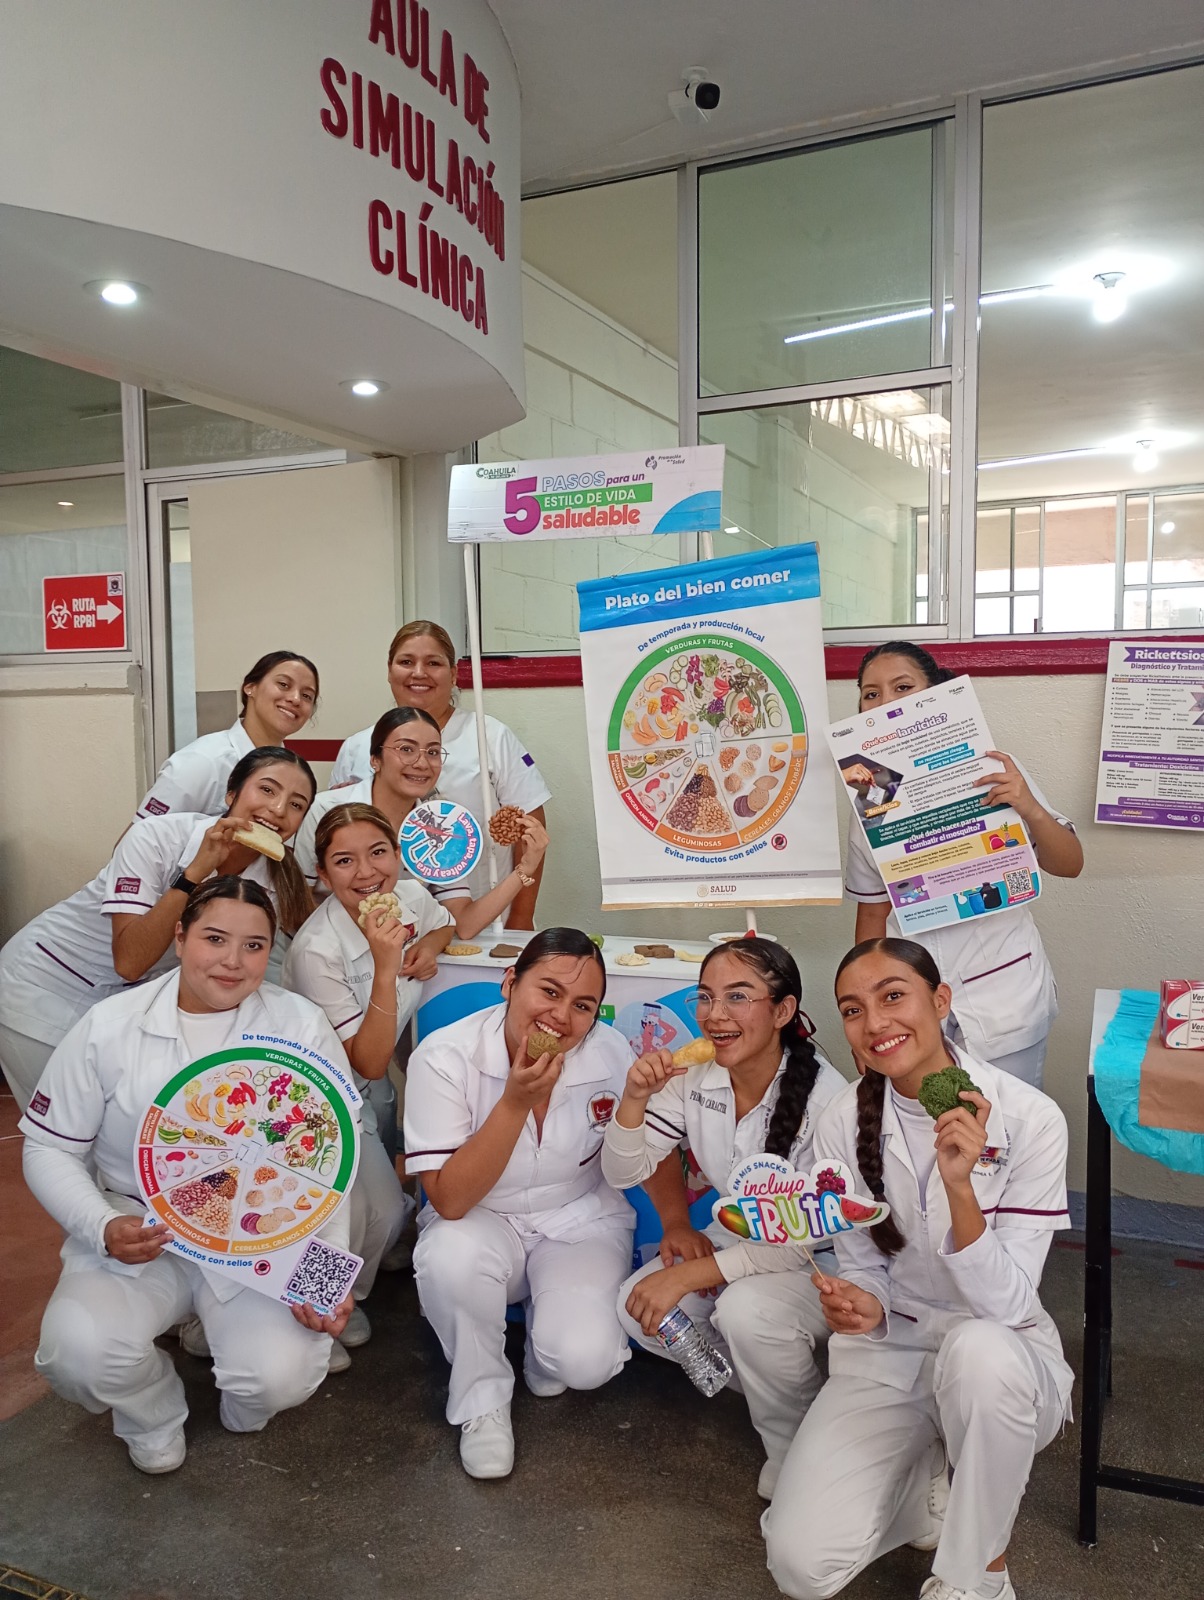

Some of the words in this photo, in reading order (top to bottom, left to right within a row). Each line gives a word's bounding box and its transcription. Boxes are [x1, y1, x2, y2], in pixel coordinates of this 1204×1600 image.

[368, 0, 457, 106] AULA
[464, 53, 490, 144] DE
[320, 57, 505, 261] SIMULACIÓN
[368, 199, 488, 335] CLÍNICA
[503, 476, 542, 535] 5
[542, 470, 606, 492] PASOS
[606, 475, 630, 487] para
[632, 472, 645, 482] un
[544, 492, 584, 508] ESTILO
[586, 491, 602, 504] DE
[605, 488, 636, 502] VIDA
[542, 504, 640, 530] saludable
[605, 593, 650, 610] Plato
[654, 585, 682, 602] del
[686, 580, 726, 598] bien
[731, 570, 791, 590] comer
[72, 598, 96, 612] RUTA
[74, 614, 96, 628] RPBI
[637, 641, 649, 653] De
[649, 622, 692, 645] temporada
[692, 622, 698, 630] y
[700, 620, 744, 633] producción
[745, 628, 765, 643] local
[665, 640, 702, 655] VERDURAS
[708, 639, 734, 648] FRUTAS
[860, 737, 879, 750] ¿Qué
[886, 731, 897, 740] un
[897, 712, 948, 738] larvicida?
[457, 812, 474, 836] Lava,
[909, 833, 925, 843] ¿Qué
[924, 827, 941, 837] debo
[941, 822, 959, 832] hacer
[960, 818, 976, 827] para
[910, 836, 939, 850] combatir
[945, 824, 980, 839] mosquito?
[464, 837, 477, 860] tapa,
[664, 846, 684, 861] Evita
[686, 854, 727, 864] productos
[729, 852, 744, 861] con
[745, 840, 768, 856] sellos
[672, 834, 722, 847] LEGUMINOSAS
[416, 860, 432, 876] tira
[440, 860, 468, 877] voltea
[710, 885, 737, 893] SALUD
[256, 1034, 302, 1051] temporada
[308, 1050, 346, 1085] producción
[344, 1084, 358, 1102] local
[264, 1052, 302, 1070] VERDURAS
[308, 1070, 331, 1091] FRUTAS
[732, 1178, 741, 1191] EN
[739, 1166, 752, 1179] MIS
[754, 1161, 787, 1174] SNACKS
[744, 1173, 805, 1200] incluyo
[164, 1211, 210, 1246] LEGUMINOSAS
[738, 1191, 854, 1243] FRUTA
[234, 1242, 272, 1252] CEREALES,
[272, 1231, 301, 1247] GRANOS
[208, 1256, 224, 1266] con
[226, 1259, 253, 1267] sellos
